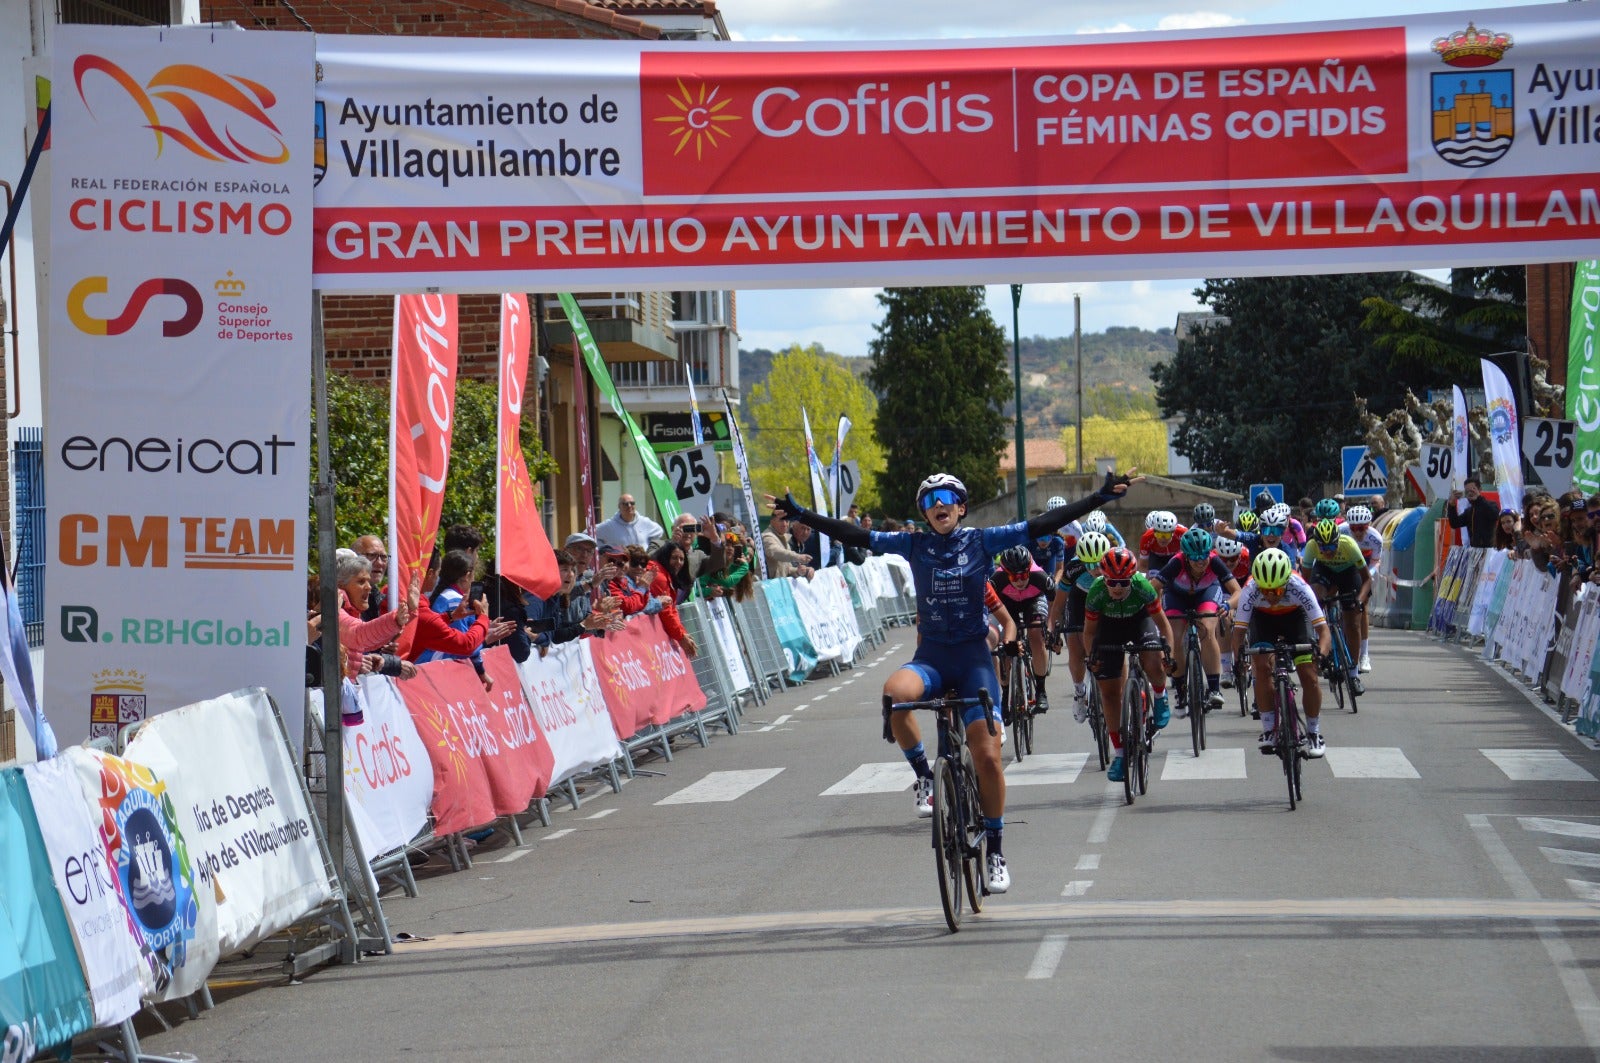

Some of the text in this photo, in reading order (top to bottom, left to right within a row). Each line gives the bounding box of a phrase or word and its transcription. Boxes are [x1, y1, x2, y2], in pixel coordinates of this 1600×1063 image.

[1033, 58, 1377, 103] COPA DE ESPAÑA
[1528, 63, 1600, 101] Ayu
[339, 94, 618, 133] Ayuntamiento de
[751, 80, 994, 138] Cofidis
[1036, 105, 1386, 146] FÉMINAS COFIDIS
[340, 138, 620, 187] Villaquilambre
[71, 177, 291, 194] REAL FEDERACIÓN ESPAÑOLA
[69, 197, 292, 236] CICLISMO
[326, 220, 480, 260] GRAN
[500, 217, 706, 257] PREMIO
[721, 206, 1141, 252] AYUNTAMIENTO
[1159, 203, 1231, 240] DE
[217, 302, 268, 315] Consejo
[218, 315, 272, 328] Superior
[217, 328, 293, 343] de Deportes
[61, 434, 296, 476] eneicat
[1426, 447, 1451, 479] 50
[1534, 421, 1574, 468] 25
[669, 448, 711, 500] 25
[59, 513, 295, 568] CM TEAM
[121, 617, 290, 647] RBHGlobal
[211, 799, 229, 826] de
[220, 841, 239, 869] de
